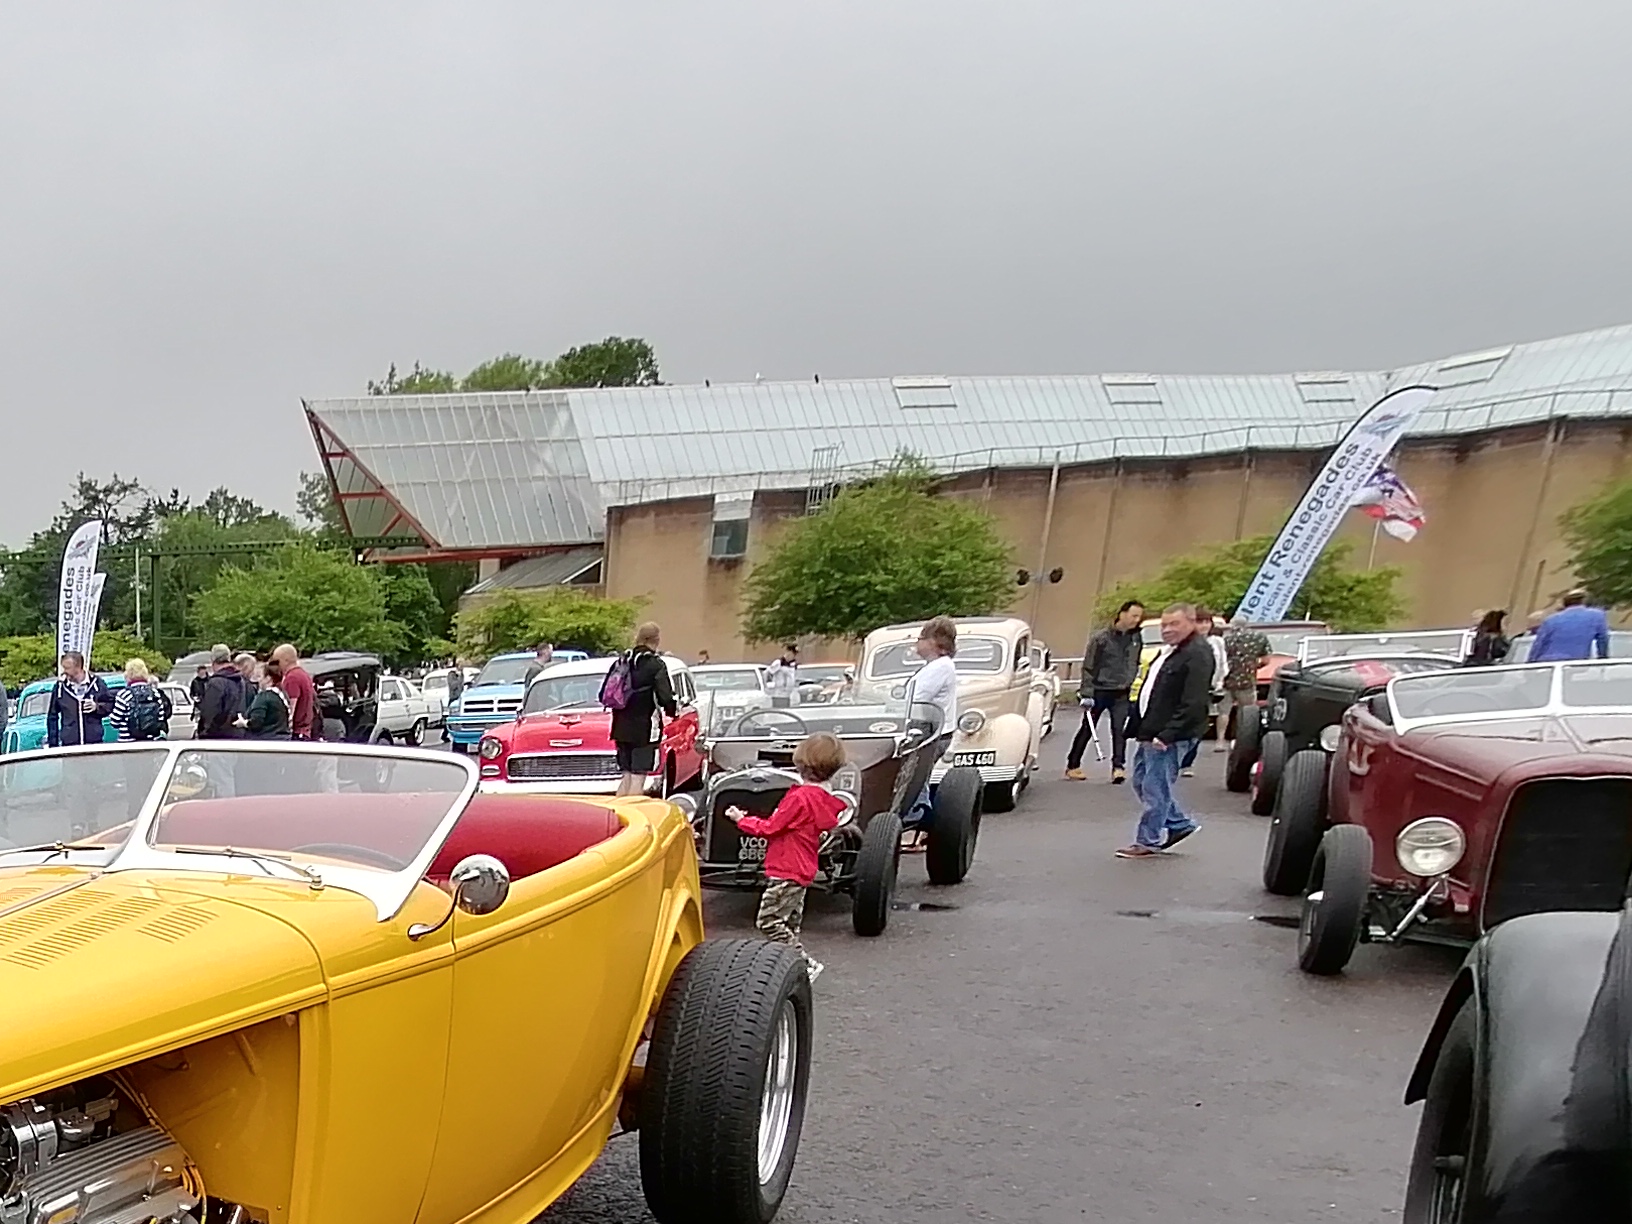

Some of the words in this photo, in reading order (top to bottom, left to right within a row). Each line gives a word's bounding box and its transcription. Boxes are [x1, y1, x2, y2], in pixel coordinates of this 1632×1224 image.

[1240, 573, 1276, 621] lent
[1269, 442, 1359, 568] Renegades
[1283, 569, 1293, 579] &
[1292, 513, 1328, 563] Classic
[1325, 482, 1346, 510] Car
[1345, 447, 1372, 481] Club
[76, 566, 85, 592] Club
[62, 567, 75, 653] enegades
[954, 754, 975, 766] GAS
[740, 836, 768, 849] VCO
